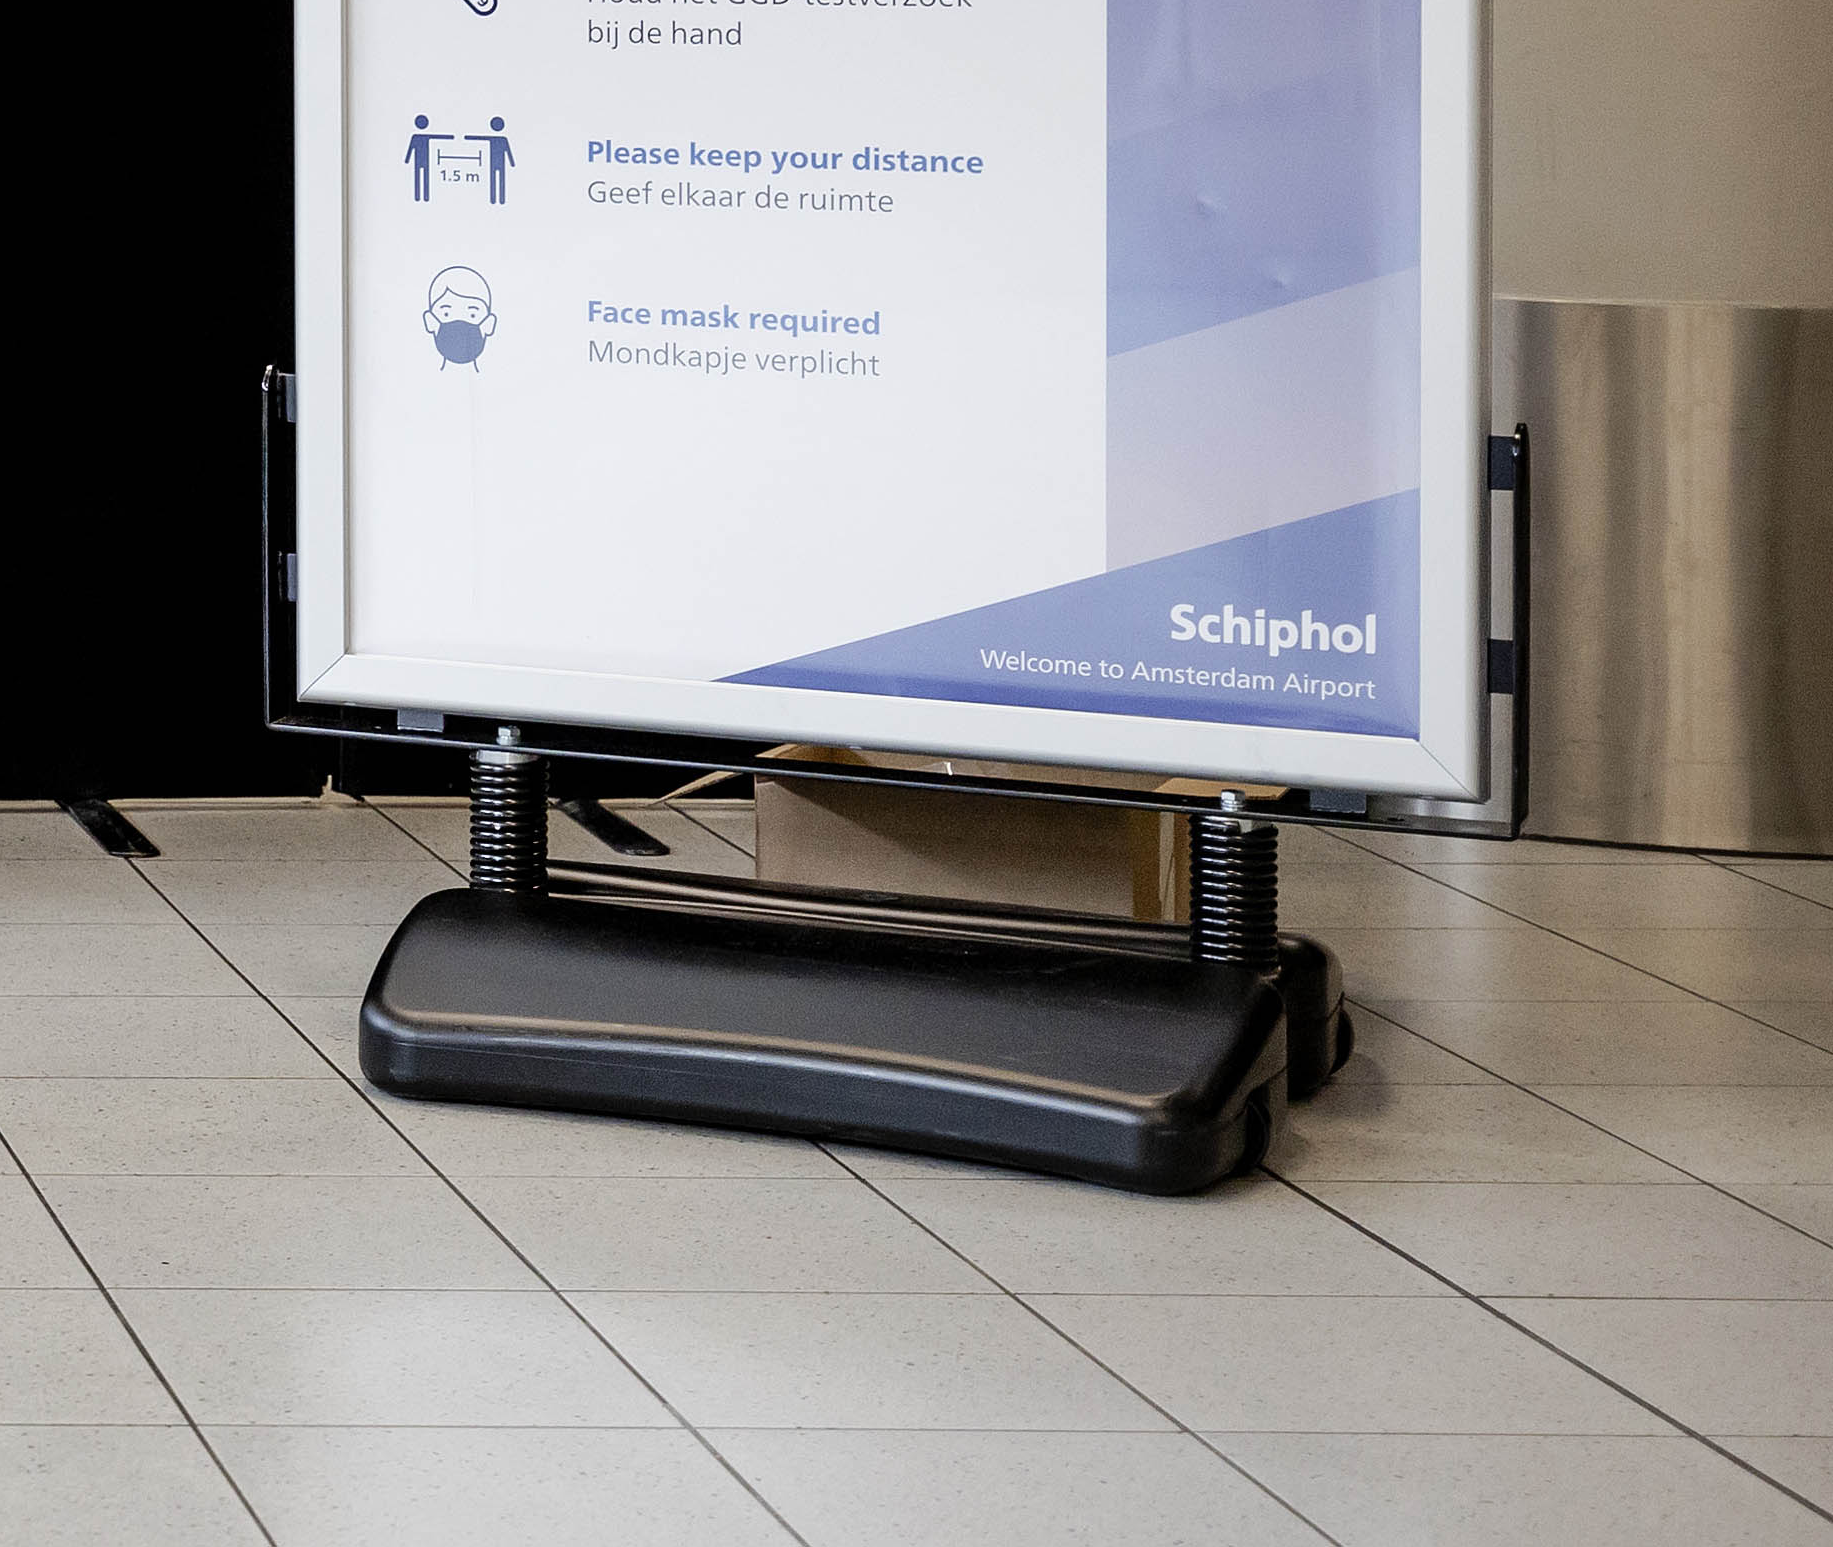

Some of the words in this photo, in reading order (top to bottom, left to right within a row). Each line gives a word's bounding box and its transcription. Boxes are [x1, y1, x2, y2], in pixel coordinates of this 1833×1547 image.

[589, 19, 618, 49] bij
[629, 20, 661, 44] de
[672, 20, 741, 45] hand
[588, 140, 679, 165] Please
[690, 142, 761, 173] keep
[771, 151, 843, 174] your
[853, 147, 983, 174] distance
[441, 170, 460, 181] 1.5
[466, 174, 479, 182] m
[588, 181, 652, 204] Geef
[661, 182, 746, 207] elkaar
[755, 185, 789, 209] de
[800, 188, 893, 212] ruimte
[589, 301, 651, 324] Face
[661, 305, 739, 328] mask
[750, 310, 880, 337] required
[589, 340, 746, 375] Mondkapje
[755, 349, 879, 379] verplicht
[1170, 604, 1376, 657] Schiphol
[980, 649, 1091, 676] Welcome
[1098, 660, 1124, 678] to
[1131, 661, 1274, 690] Amsterdam
[1283, 673, 1376, 700] Airport
